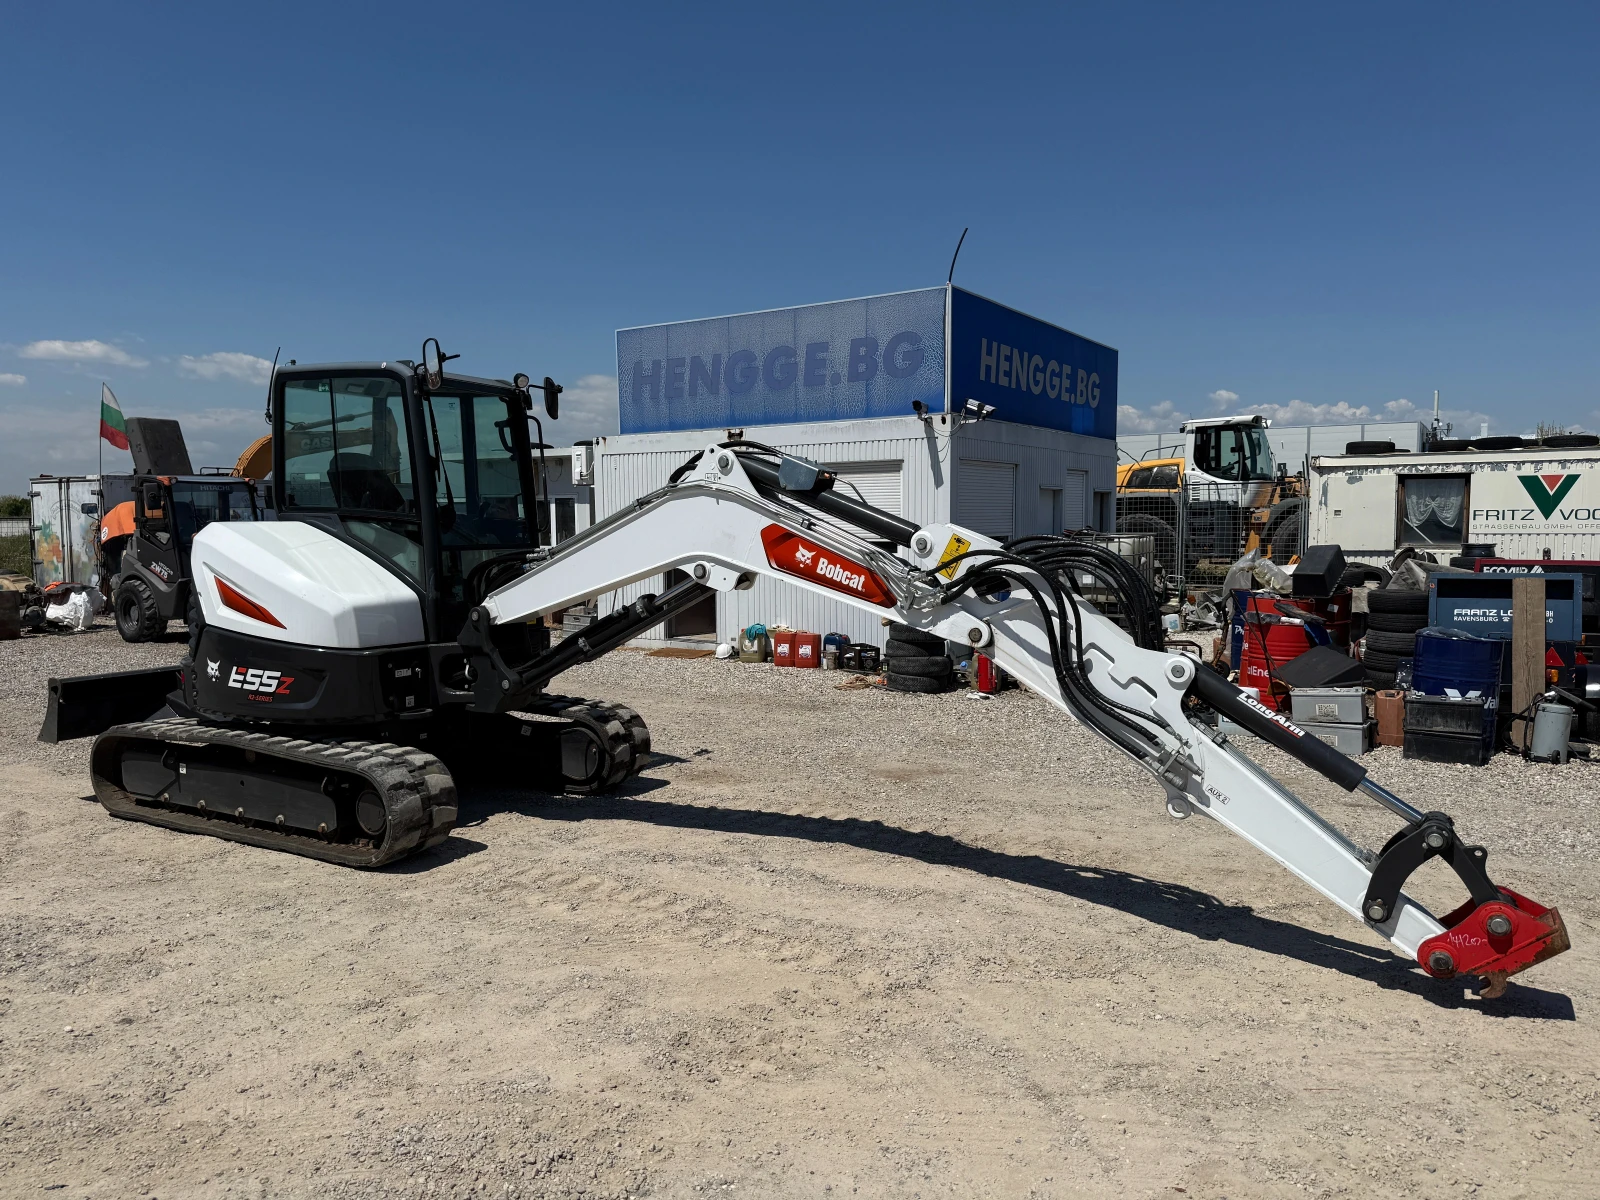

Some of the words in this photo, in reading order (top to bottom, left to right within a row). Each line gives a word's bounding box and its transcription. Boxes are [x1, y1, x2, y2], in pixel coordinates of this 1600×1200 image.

[631, 331, 925, 400] HENGGE.BG
[979, 338, 1101, 408] HENGGE.BG
[300, 436, 333, 451] CAS
[1472, 509, 1535, 521] FRITZ
[150, 561, 168, 579] ZW75
[816, 557, 865, 591] Bobcat
[1453, 608, 1498, 616] FRANZ
[1453, 615, 1499, 623] RAVENSBURG
[1238, 692, 1306, 738] LongArm
[1207, 786, 1222, 800] AUX
